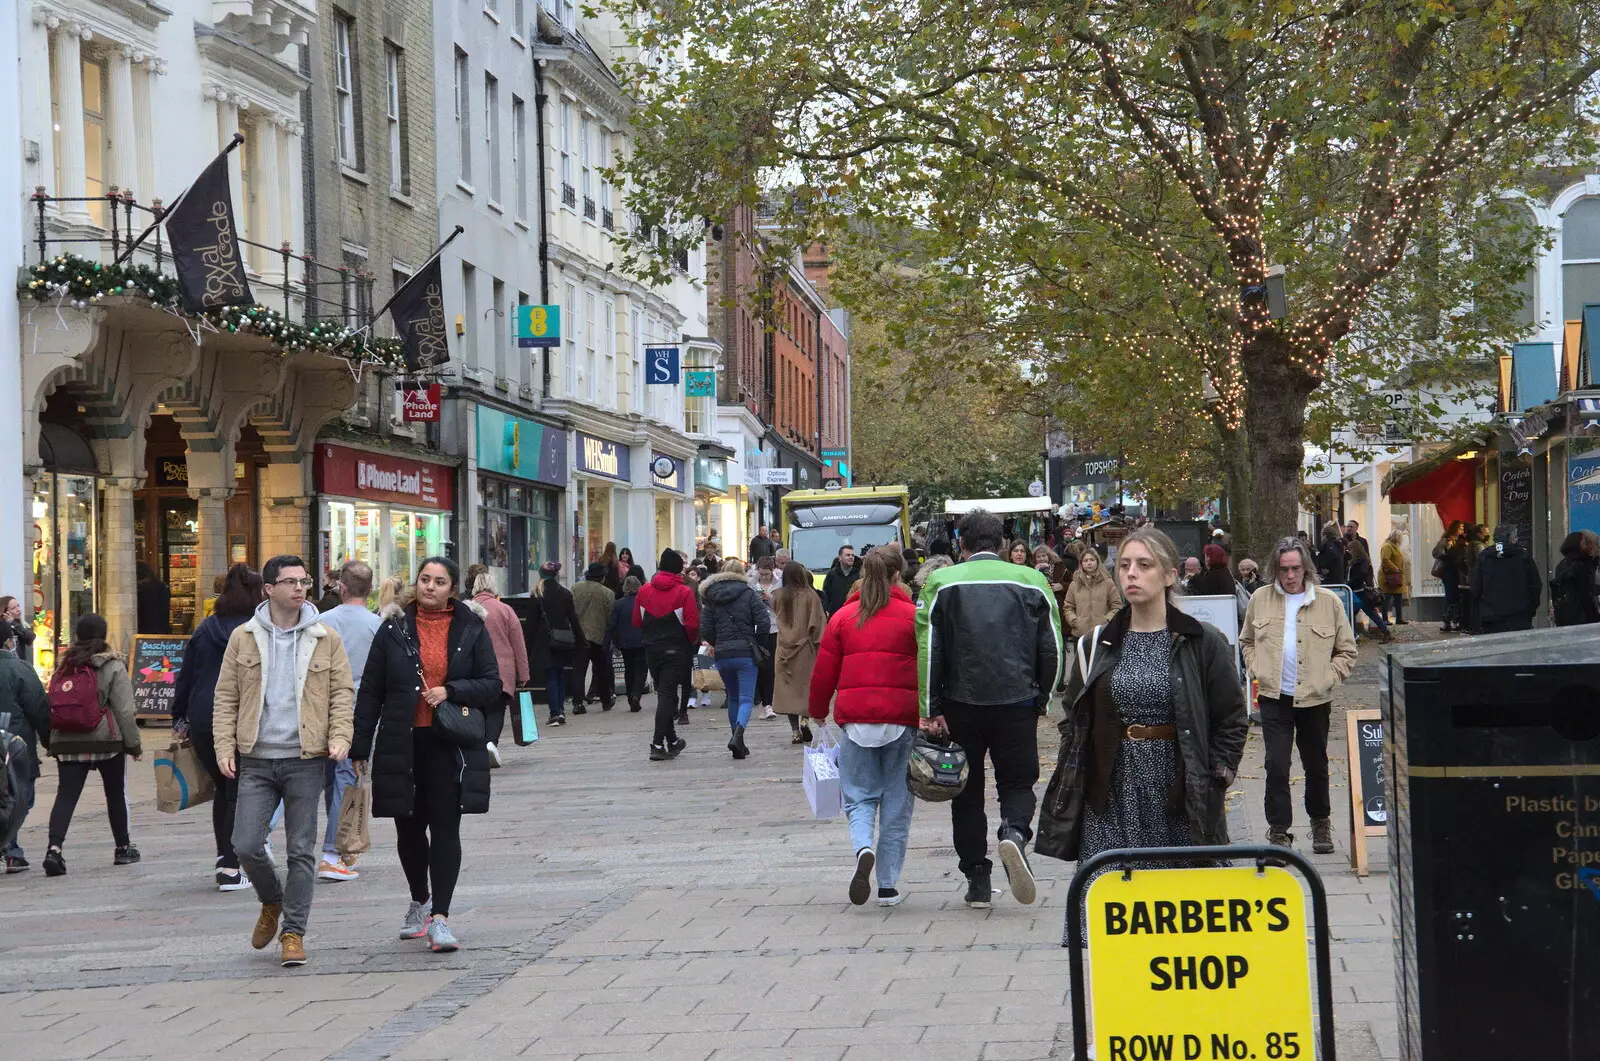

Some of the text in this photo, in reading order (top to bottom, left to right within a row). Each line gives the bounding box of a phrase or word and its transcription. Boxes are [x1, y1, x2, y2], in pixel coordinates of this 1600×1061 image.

[654, 358, 671, 382] S
[405, 402, 438, 410] Phone
[409, 410, 434, 418] Land
[583, 437, 618, 475] WHSmith
[1085, 460, 1118, 476] TOPSHOP
[1502, 468, 1530, 482] Catch
[366, 464, 397, 491] Phone
[396, 469, 420, 495] Land
[1504, 490, 1529, 501] Day
[134, 687, 151, 697] ANY
[151, 687, 158, 697] 4
[141, 698, 169, 711] £9.99
[1505, 795, 1577, 812] Plastic
[1104, 897, 1290, 935] BARBER'S
[1149, 955, 1249, 991] SHOP
[1109, 1032, 1300, 1061] ROW D No. 85
